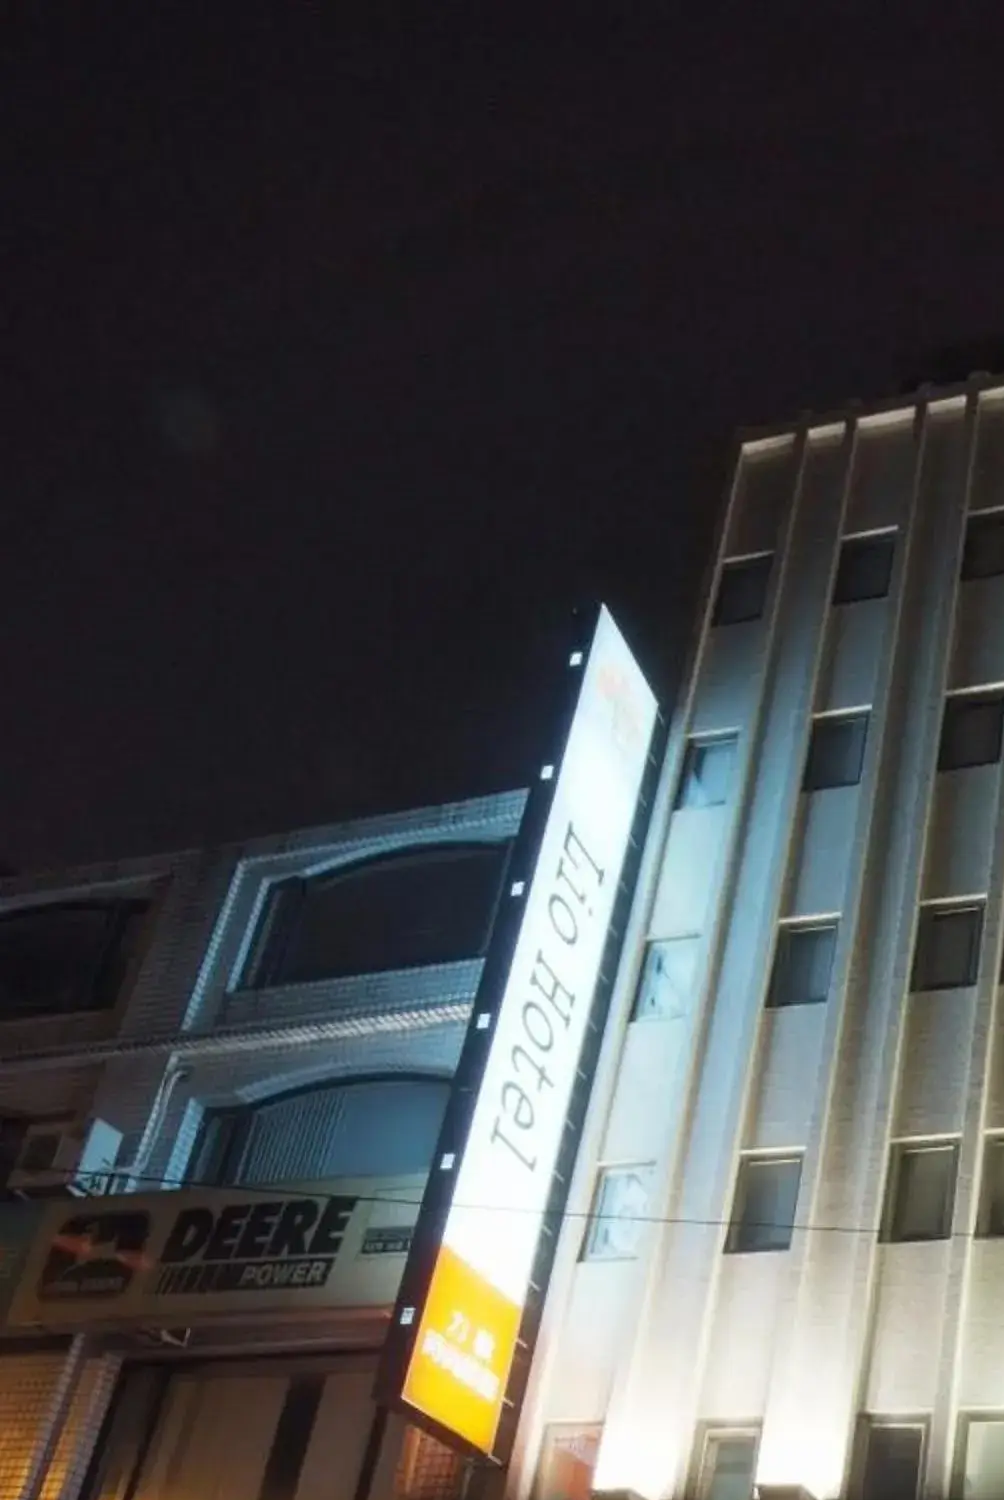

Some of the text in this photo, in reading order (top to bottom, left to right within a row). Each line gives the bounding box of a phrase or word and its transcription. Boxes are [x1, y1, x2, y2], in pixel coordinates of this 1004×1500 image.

[490, 820, 605, 1173] Lio Hotel
[160, 1195, 358, 1262] DEERE
[238, 1261, 327, 1287] POWER
